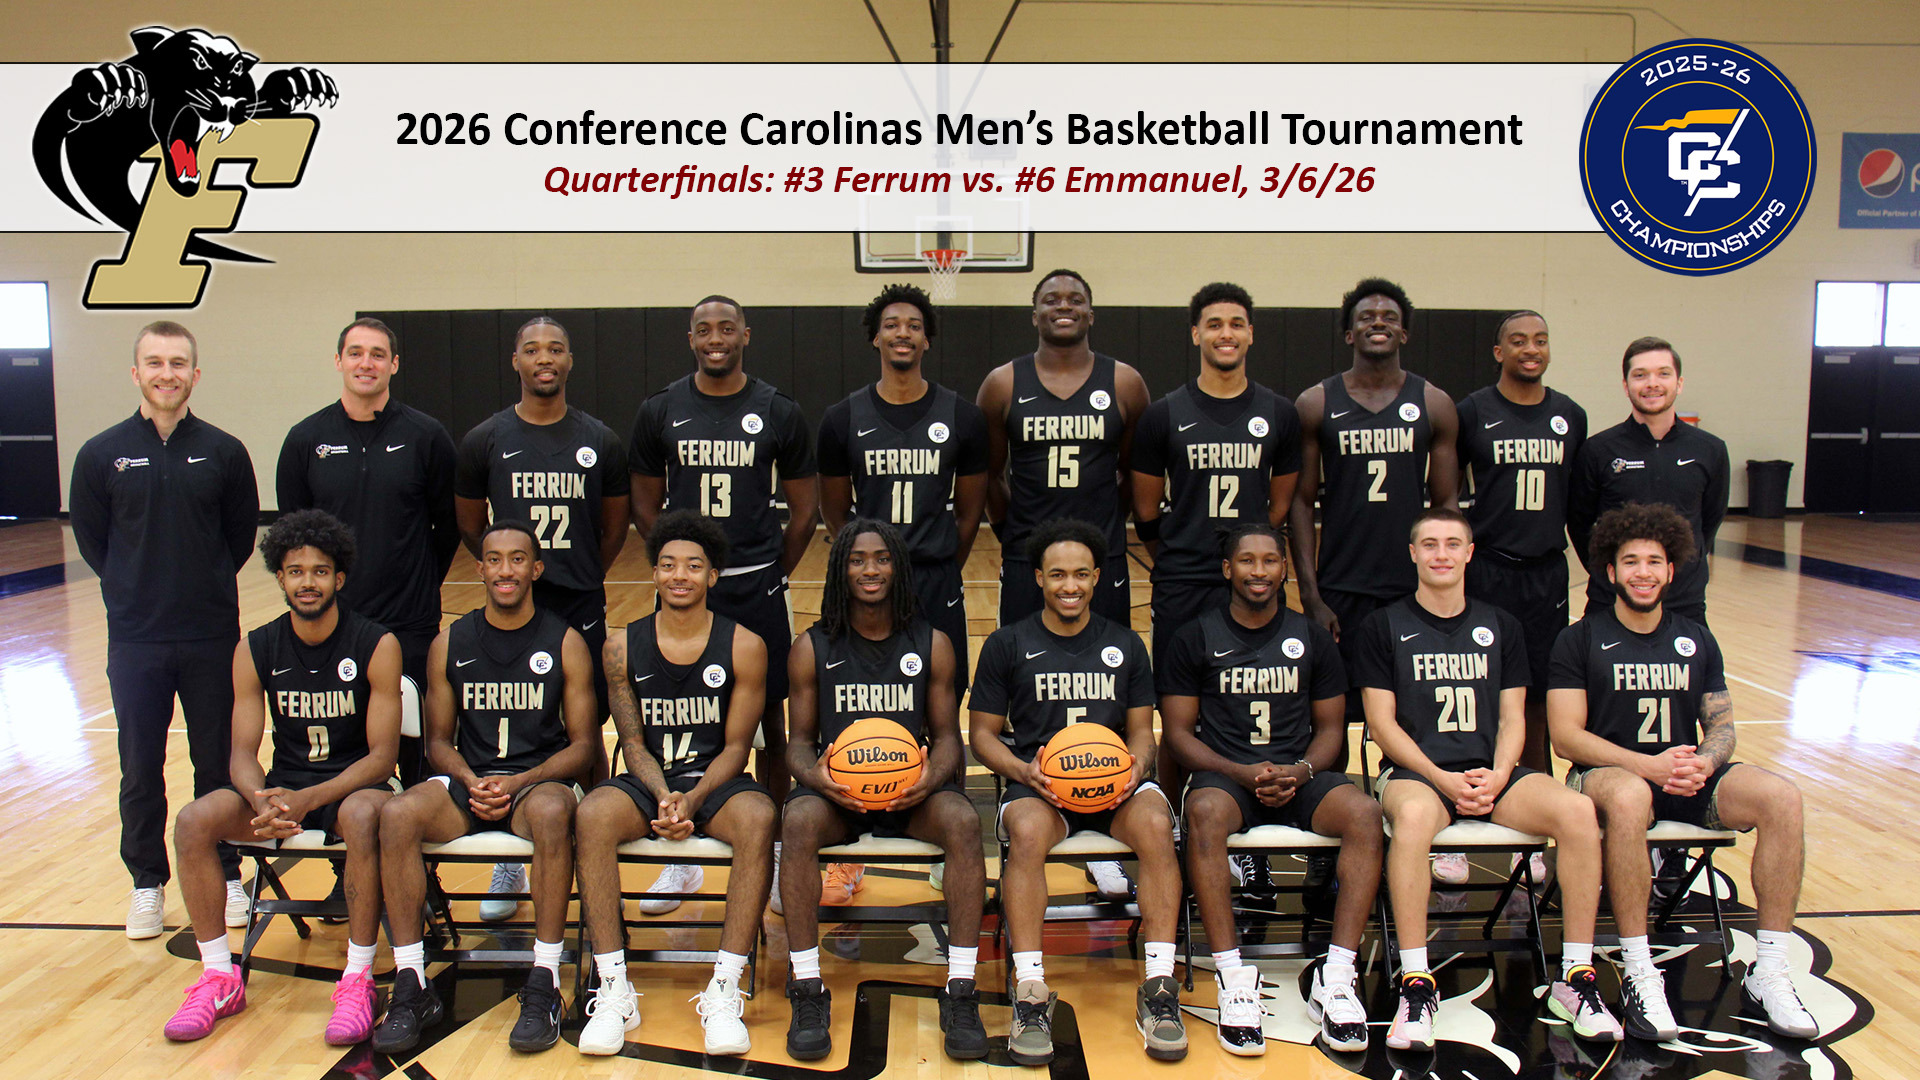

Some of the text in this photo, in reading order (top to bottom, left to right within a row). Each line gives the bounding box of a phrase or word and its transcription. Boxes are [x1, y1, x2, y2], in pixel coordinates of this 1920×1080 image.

[1883, 209, 1909, 217] Partner
[1023, 414, 1105, 442] FERRUM
[1338, 427, 1414, 455] FERRUM
[677, 439, 756, 467] FERRUM
[864, 448, 941, 476] FERRUM
[1186, 442, 1262, 470] FERRUM
[1492, 438, 1564, 465] FERRUM
[1047, 445, 1080, 488] 15
[1367, 459, 1388, 502] 2
[511, 471, 586, 500] FERRUM
[699, 472, 732, 518] 13
[1208, 474, 1240, 518] 12
[1515, 469, 1546, 511] 10
[891, 480, 914, 524] 11
[530, 505, 572, 549] 22
[1219, 665, 1299, 694] FERRUM
[1412, 652, 1488, 681] FERRUM
[1612, 662, 1690, 691] FERRUM
[462, 682, 545, 710] FERRUM
[834, 683, 914, 713] FERRUM
[1034, 672, 1116, 702] FERRUM
[276, 689, 356, 719] FERRUM
[640, 695, 721, 726] FERRUM
[1434, 685, 1477, 733] 20
[1249, 700, 1271, 745] 3
[1637, 697, 1671, 743] 21
[307, 725, 330, 762] 0
[496, 717, 509, 759] 1
[846, 746, 909, 766] Wilson
[1058, 752, 1120, 772] Wilson
[861, 781, 898, 795] EVO
[1071, 782, 1115, 799] NCAA
